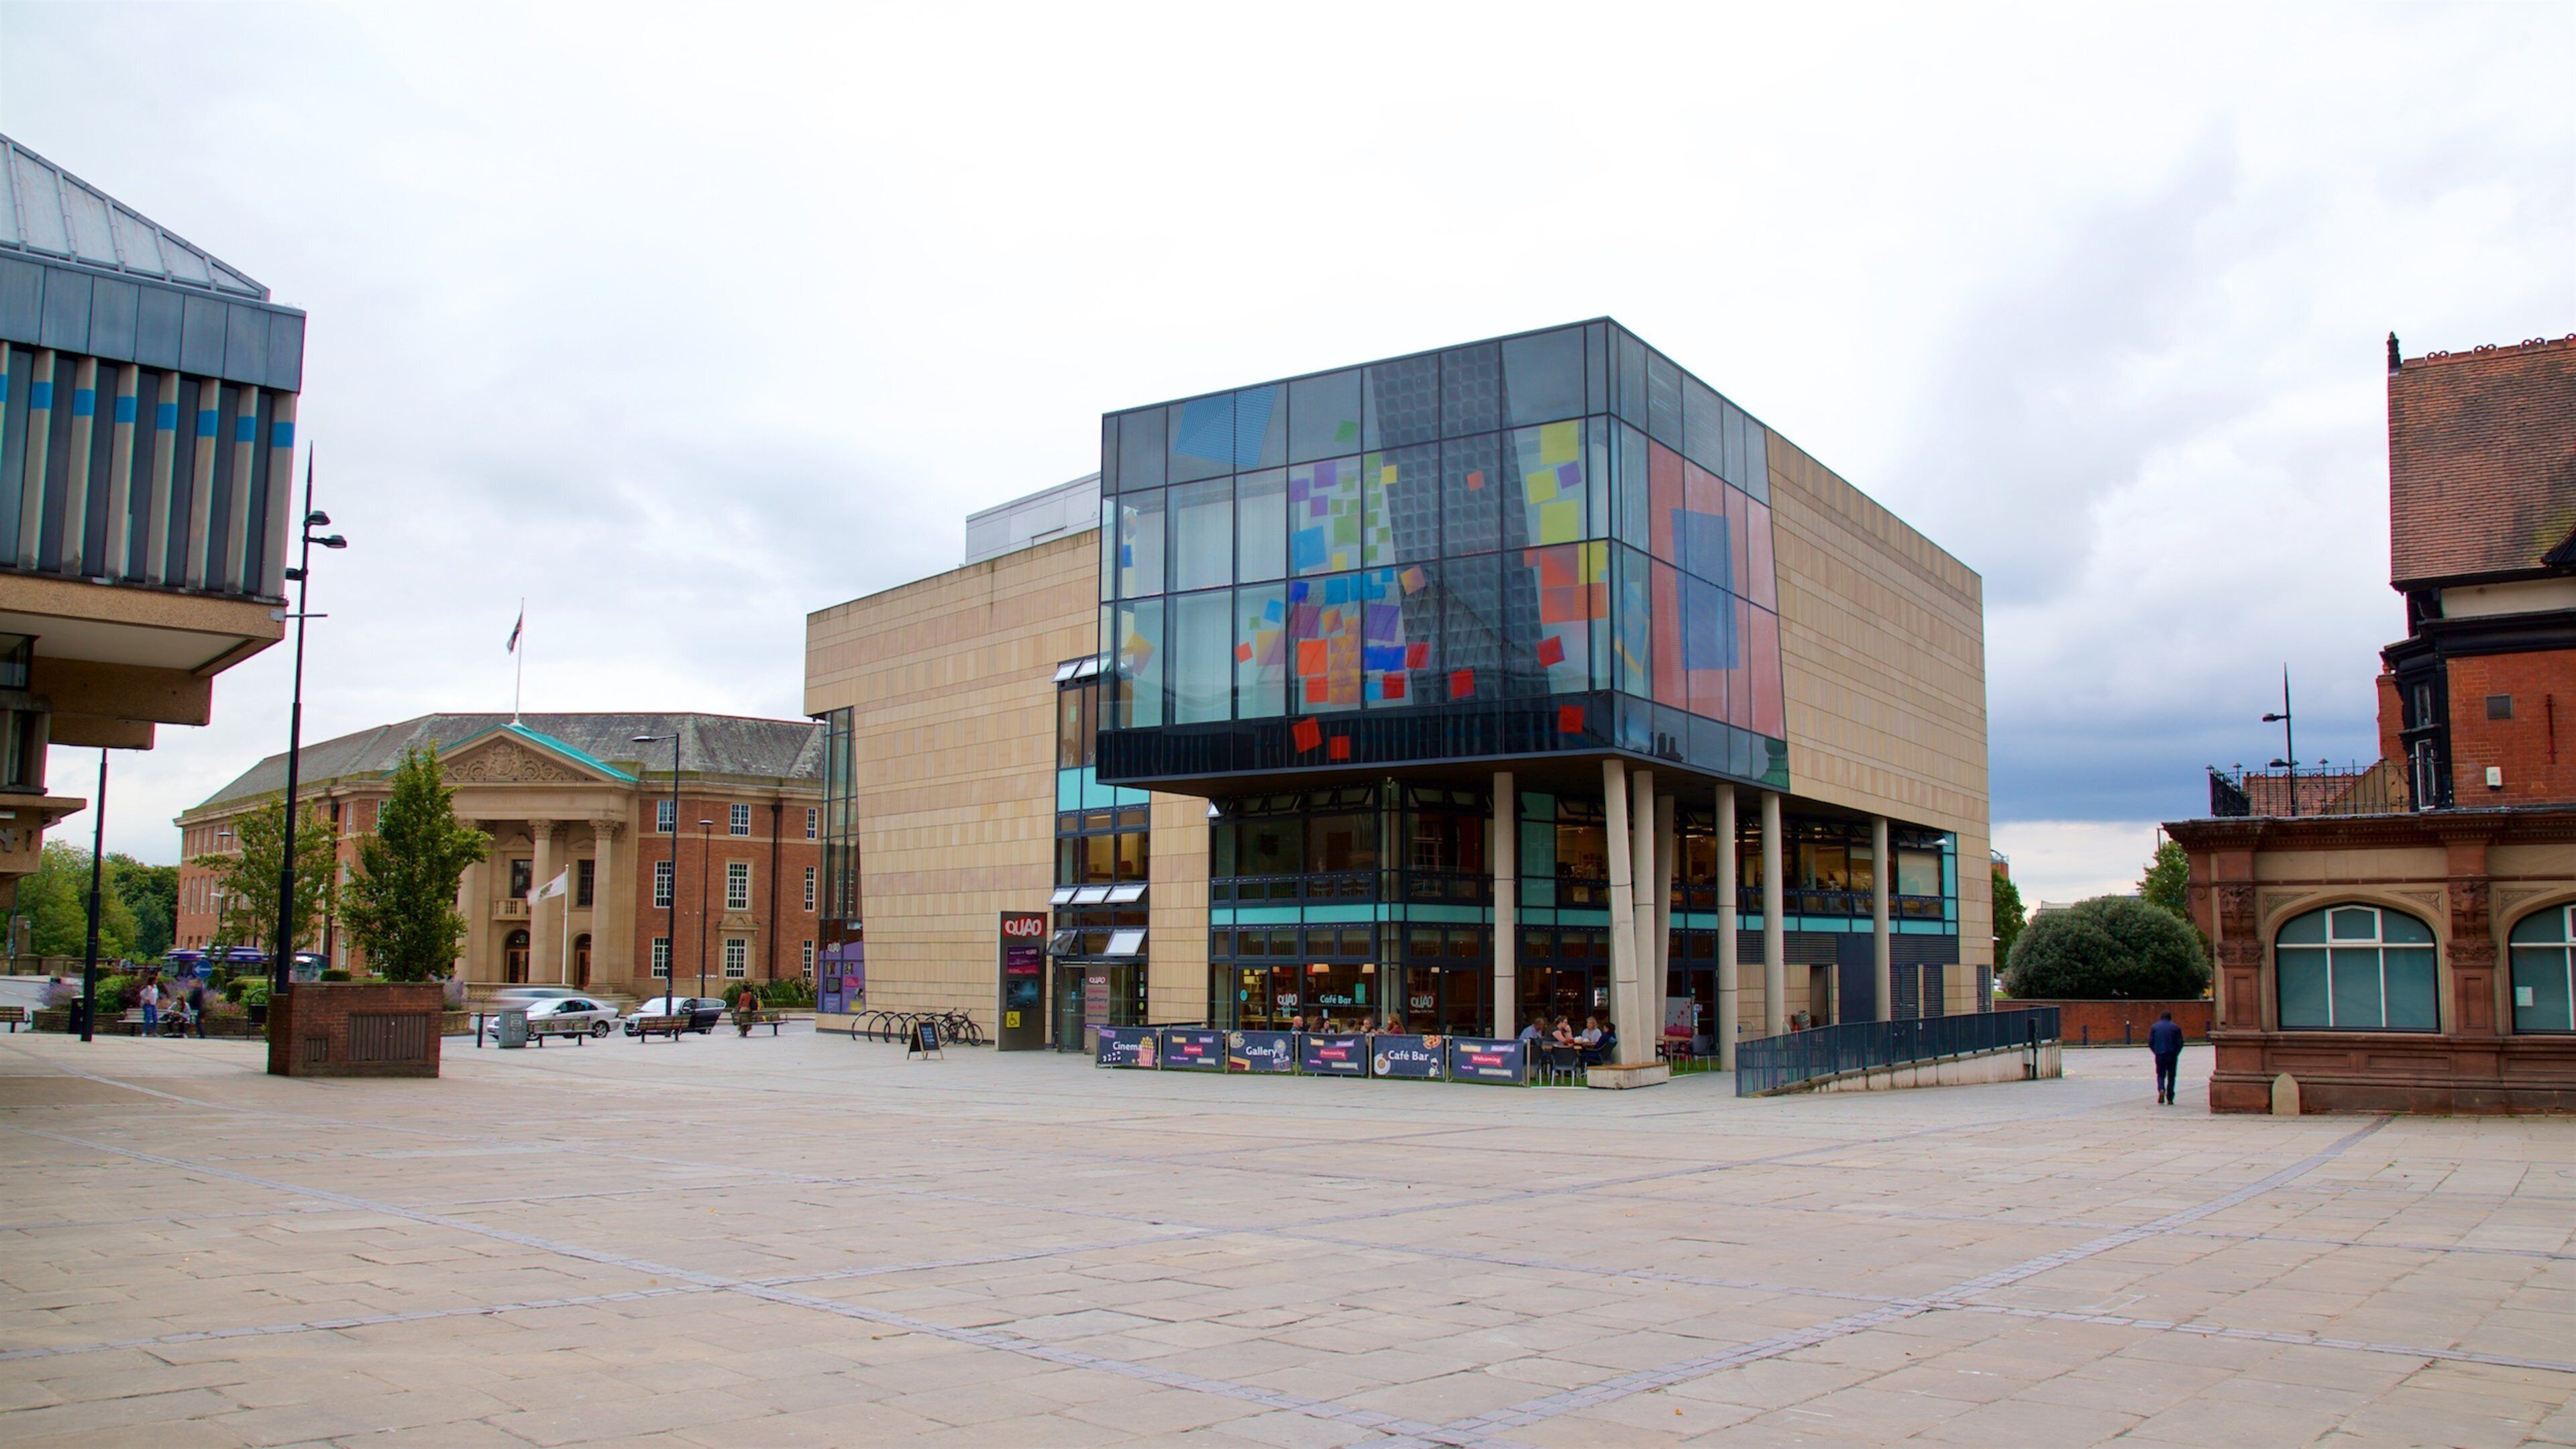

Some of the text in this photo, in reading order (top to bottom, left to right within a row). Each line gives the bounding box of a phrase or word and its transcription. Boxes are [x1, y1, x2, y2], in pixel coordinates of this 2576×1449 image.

[1320, 994, 1352, 1004] Café Bar
[1112, 1041, 1142, 1051] Cinema
[1246, 1046, 1277, 1058] Gallery
[1387, 1049, 1430, 1061] Café Bar
[1472, 1055, 1501, 1063] Welcoming
